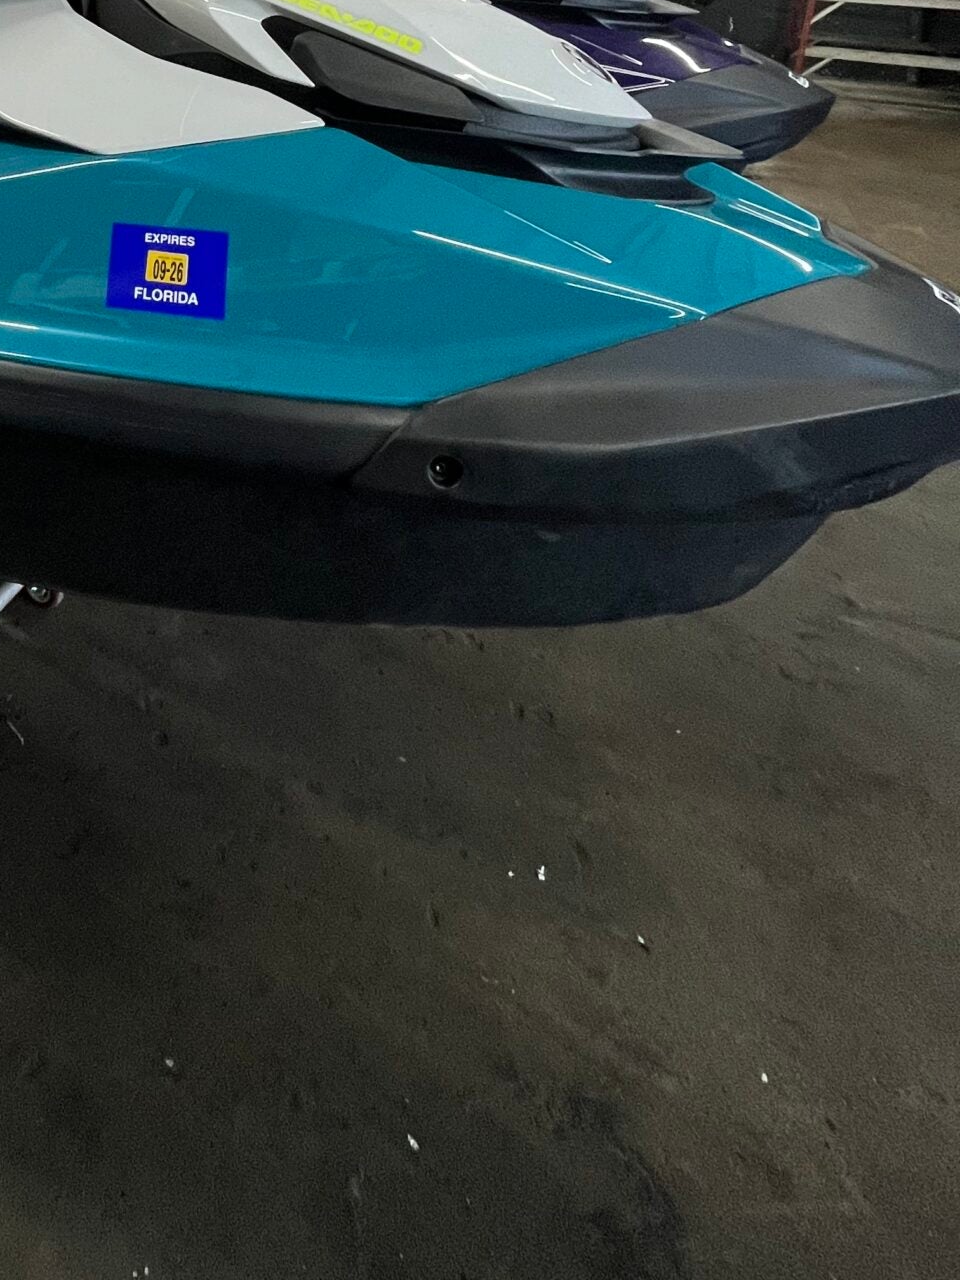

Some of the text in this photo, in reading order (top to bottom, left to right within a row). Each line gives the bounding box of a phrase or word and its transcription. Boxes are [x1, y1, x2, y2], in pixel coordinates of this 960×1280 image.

[144, 232, 196, 247] EXPIRES
[153, 259, 184, 282] 09-26
[134, 286, 198, 306] FLORIDA
